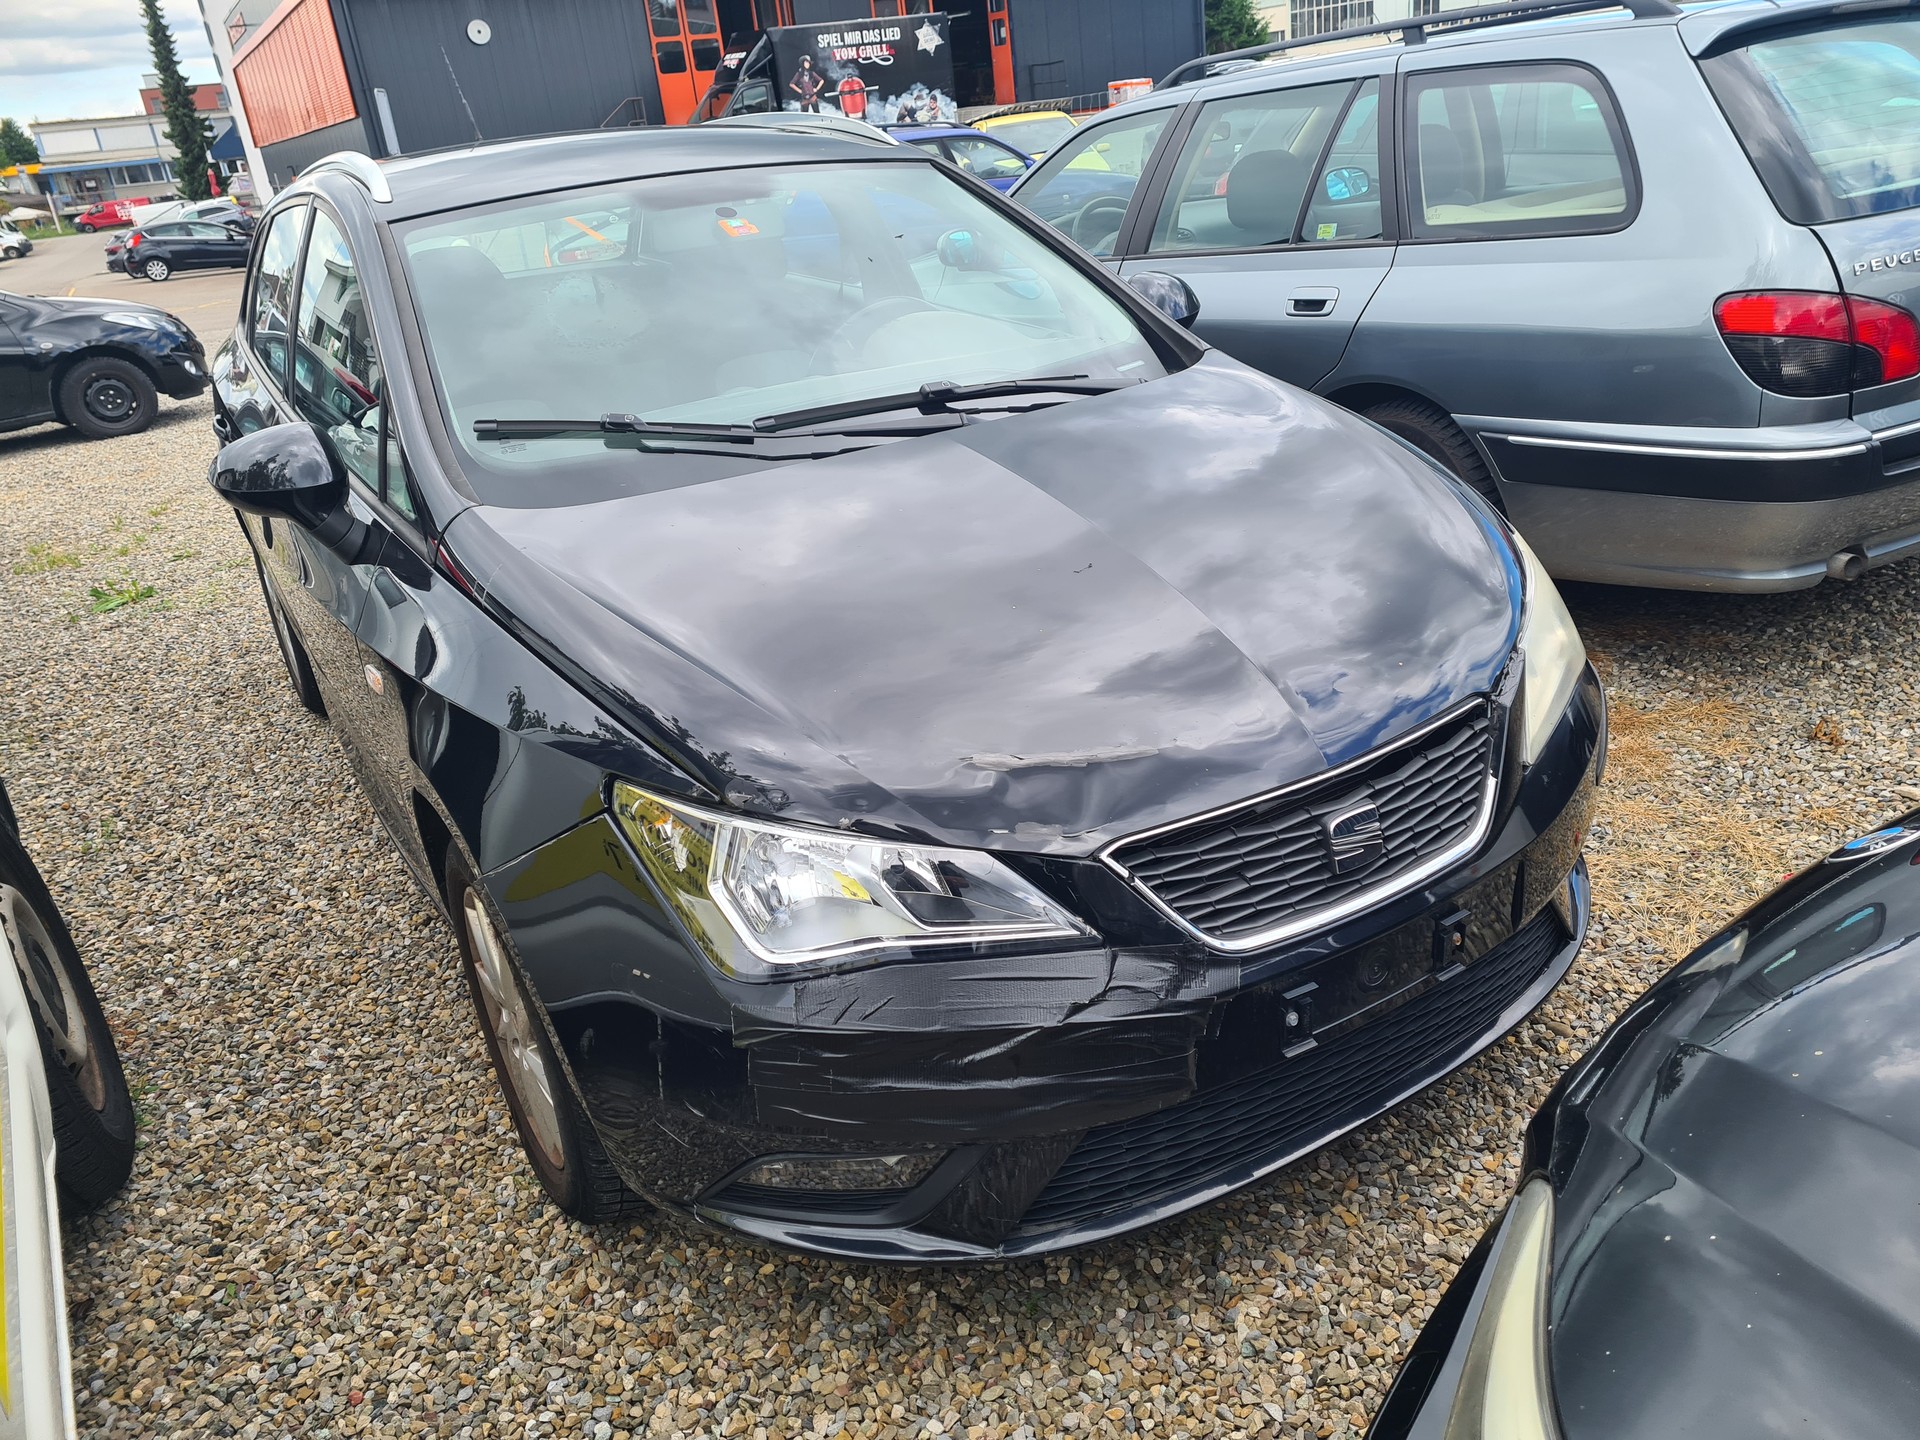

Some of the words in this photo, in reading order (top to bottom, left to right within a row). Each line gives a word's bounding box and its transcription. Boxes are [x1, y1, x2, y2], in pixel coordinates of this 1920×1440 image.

[817, 31, 844, 48] SPIEL
[843, 30, 863, 45] MIR
[862, 28, 881, 43] DAS
[881, 26, 901, 41] LIED
[833, 46, 858, 61] VOM
[858, 43, 892, 61] GRILL
